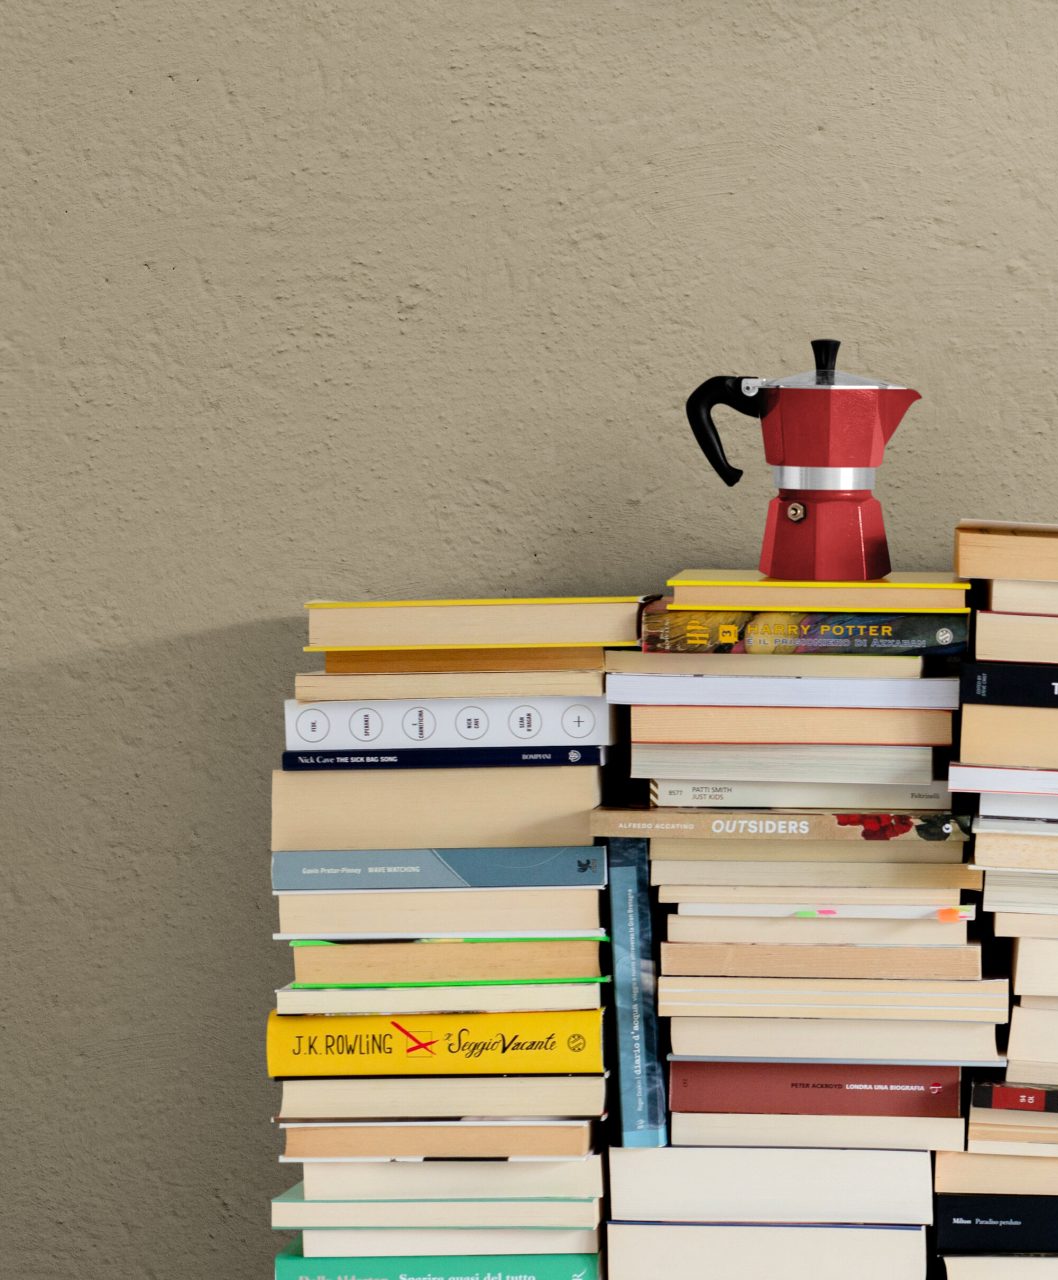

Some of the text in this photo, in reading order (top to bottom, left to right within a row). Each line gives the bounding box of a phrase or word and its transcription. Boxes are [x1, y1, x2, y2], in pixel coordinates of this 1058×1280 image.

[747, 624, 893, 636] HARRY POTTER
[298, 756, 315, 764] Nick
[316, 756, 335, 764] Cave
[711, 786, 733, 794] SMITH
[618, 822, 653, 830] ALFREDO
[711, 819, 809, 834] OUTSIDERS
[448, 1028, 500, 1058] Seggio
[496, 1032, 558, 1054] Vacante
[632, 1043, 642, 1075] diario
[890, 1084, 926, 1092] BIOGRAFIA
